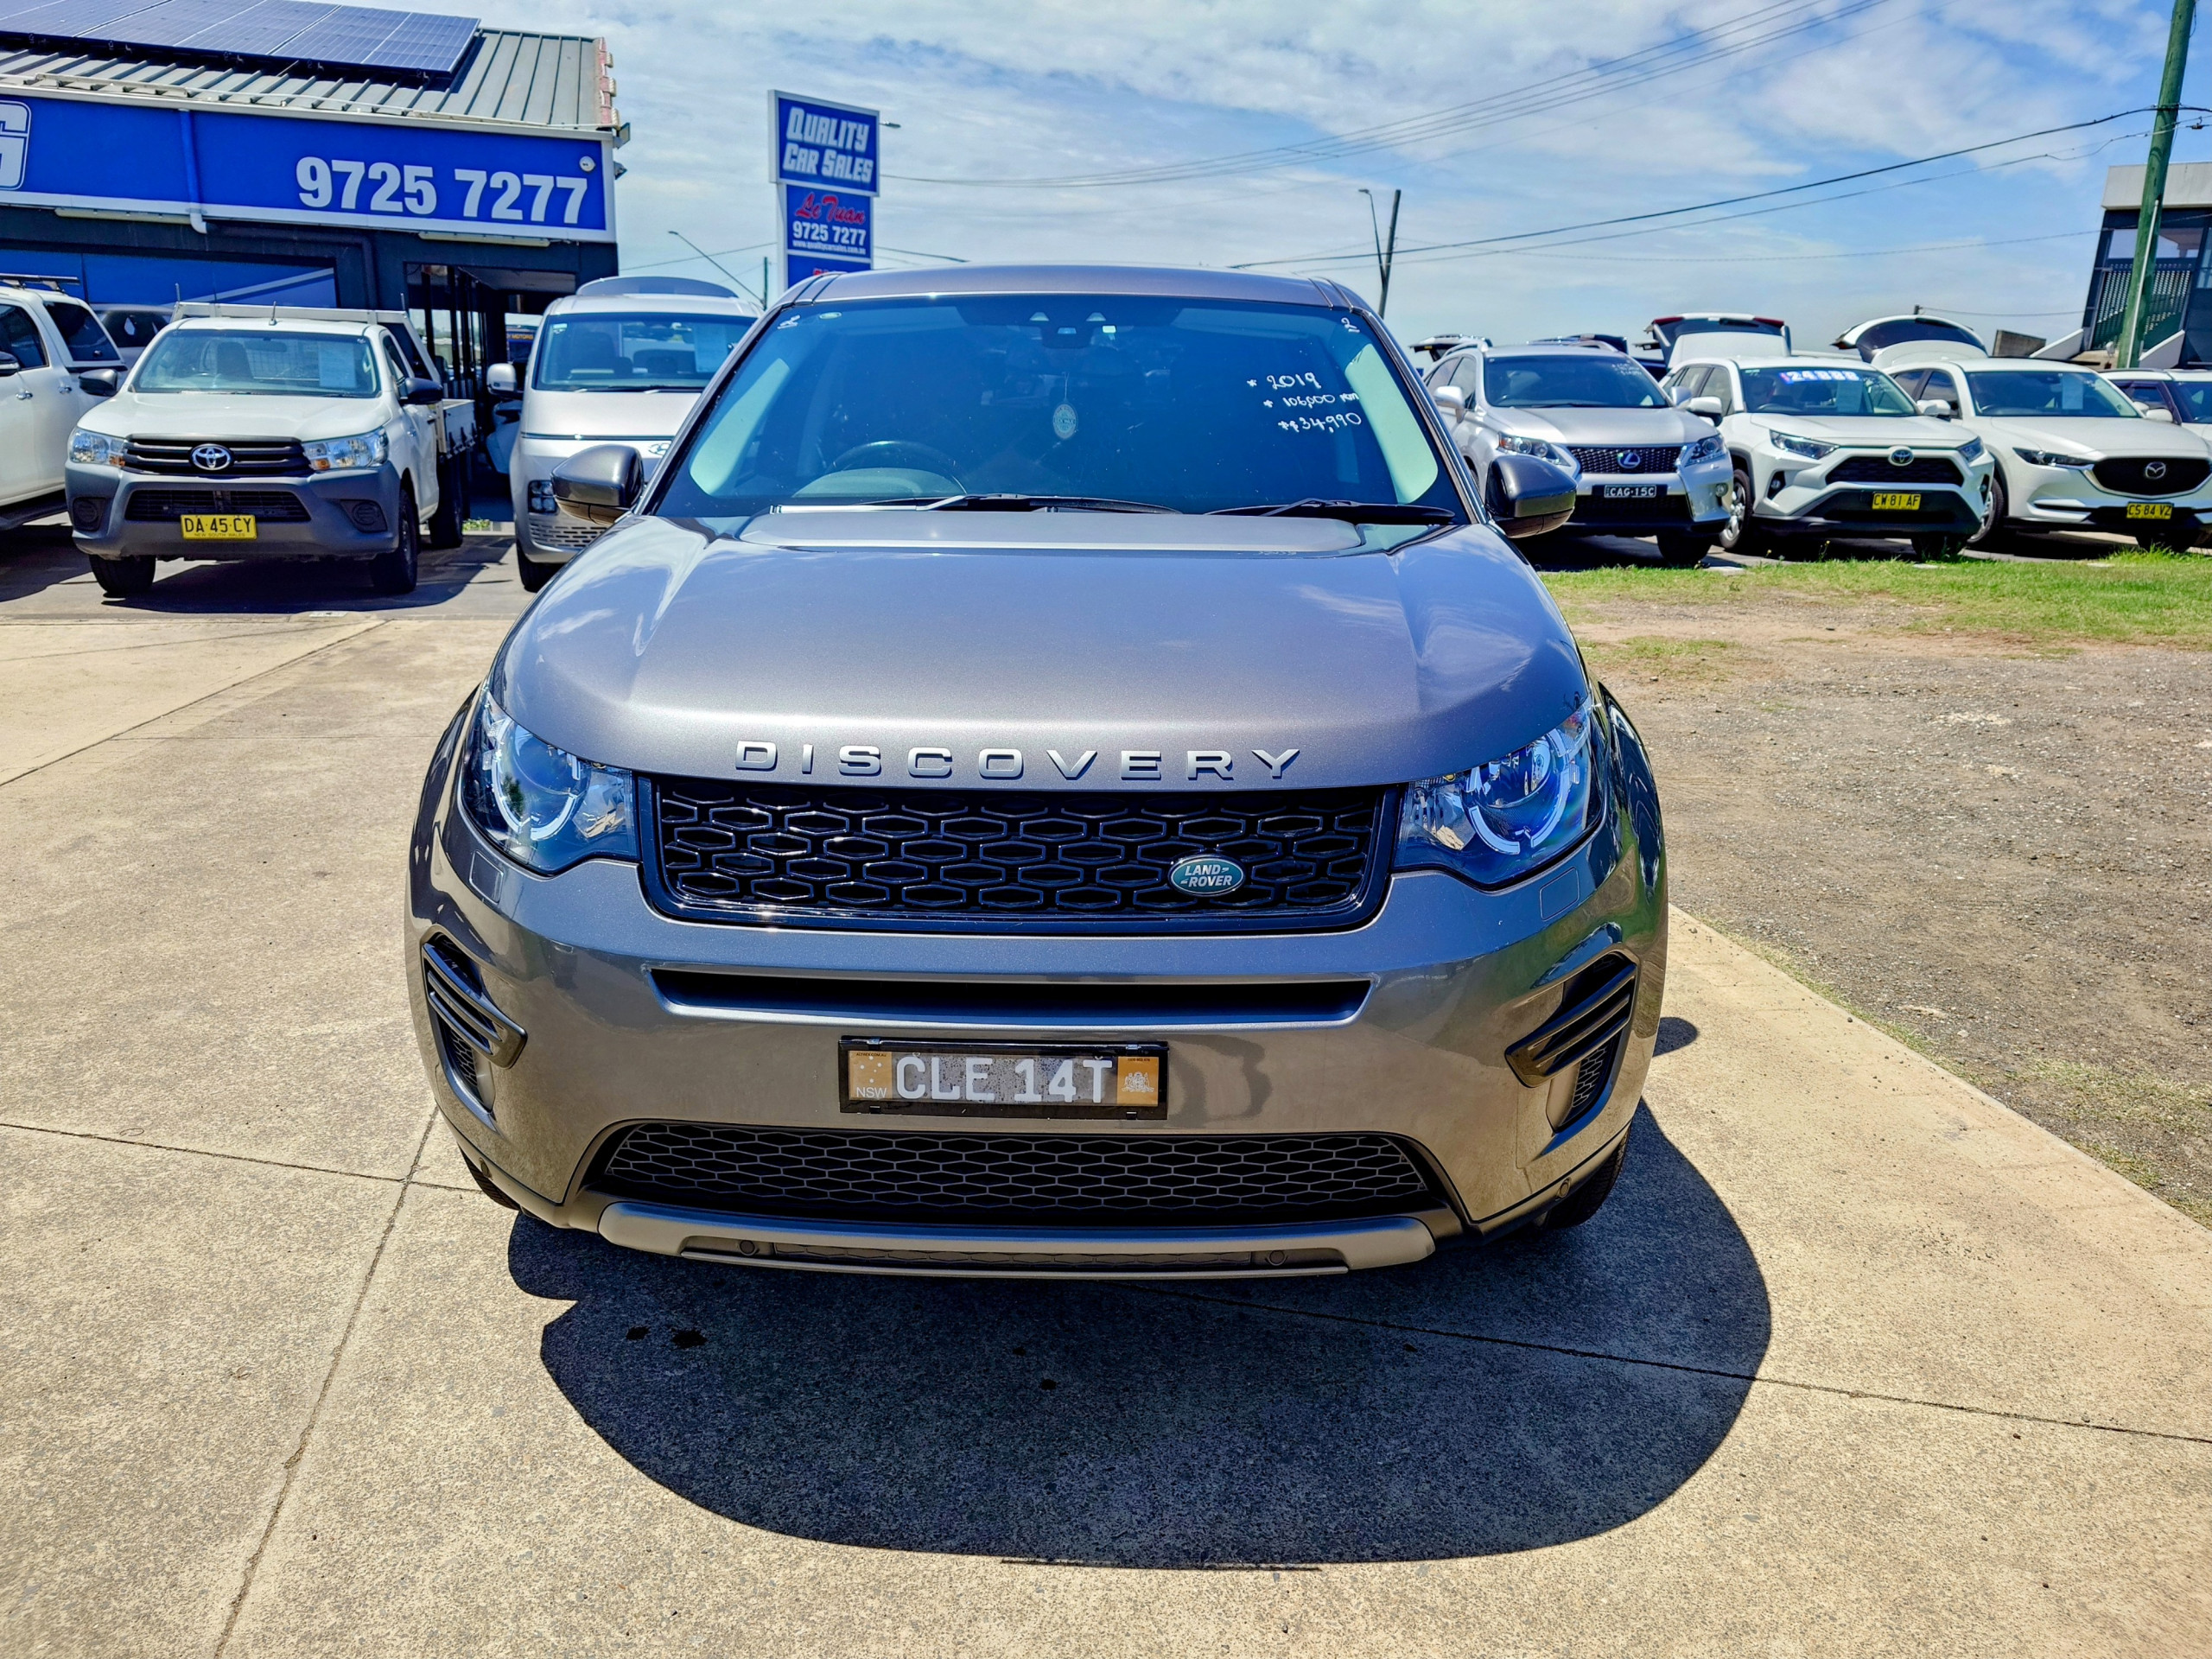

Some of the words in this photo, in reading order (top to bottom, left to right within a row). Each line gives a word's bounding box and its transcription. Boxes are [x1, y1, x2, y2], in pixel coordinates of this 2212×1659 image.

[785, 106, 870, 152] QUALITY
[782, 143, 819, 175] CAR
[822, 149, 874, 183] SALES
[296, 156, 437, 215] 9725
[454, 168, 588, 225] 7277
[795, 192, 821, 219] Le
[822, 195, 866, 225] Tuan
[792, 221, 829, 242] 9725
[832, 226, 867, 246] 7277
[1267, 372, 1322, 390] 2019
[734, 740, 1300, 781] DISCOVERY
[1185, 864, 1221, 876] LAND
[1188, 874, 1233, 887] ROVER
[856, 1086, 887, 1098] NSW
[896, 1056, 996, 1102] CLE
[1014, 1058, 1113, 1104] 14T
